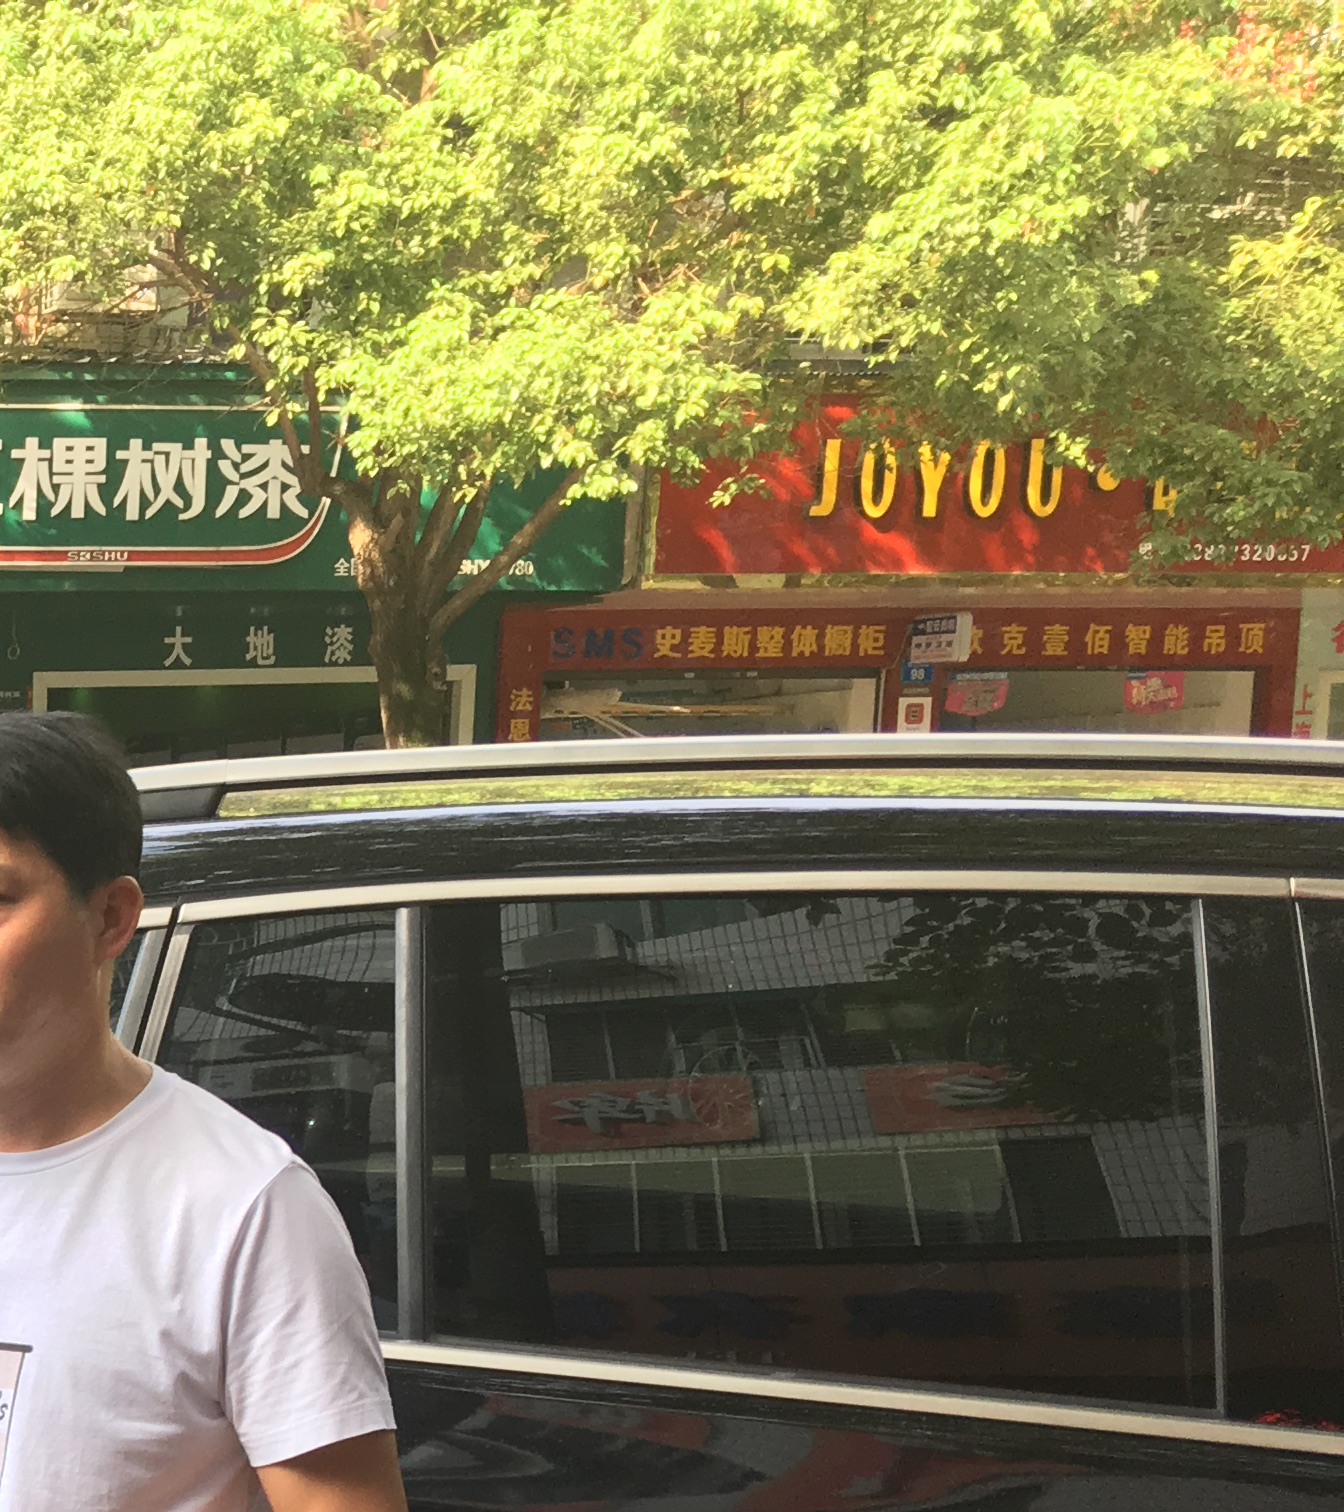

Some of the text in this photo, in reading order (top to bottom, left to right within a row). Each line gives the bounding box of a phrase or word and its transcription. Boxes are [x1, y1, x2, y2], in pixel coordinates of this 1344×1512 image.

[808, 438, 1064, 518] JOYOU
[67, 551, 129, 561] SKSHU
[163, 624, 354, 667] 大地漆
[552, 627, 645, 660] SMS
[653, 624, 886, 658] 史麦斯整体橱柜
